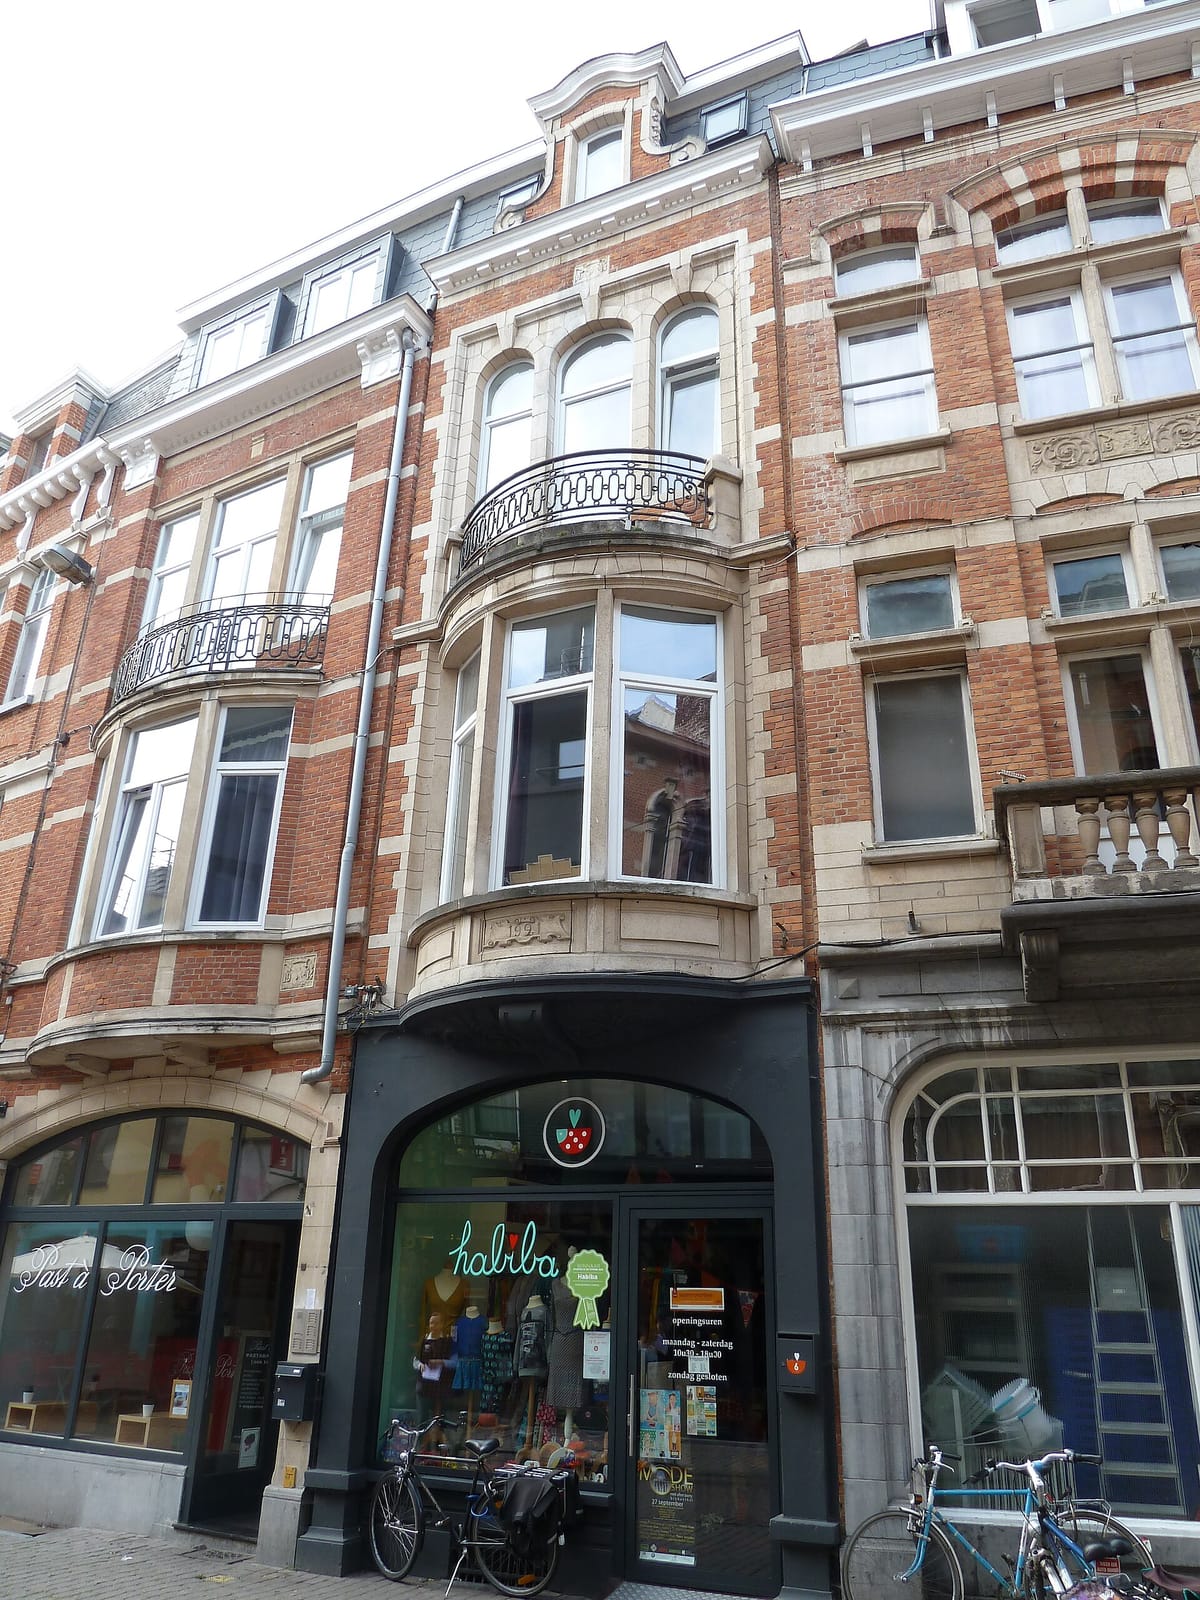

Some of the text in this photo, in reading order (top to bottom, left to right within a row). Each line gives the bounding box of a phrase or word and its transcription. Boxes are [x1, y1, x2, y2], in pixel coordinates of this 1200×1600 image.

[449, 1220, 559, 1278] habiba
[14, 1244, 177, 1296] Past à Porter
[672, 1316, 723, 1327] openingsuren
[662, 1338, 696, 1348] maandag
[701, 1339, 734, 1350] zaterdag
[673, 1349, 695, 1357] 10u30
[700, 1350, 722, 1359] 18u30
[793, 1362, 800, 1371] 6
[667, 1371, 728, 1382] zondag gesloten
[671, 1484, 693, 1493] SHOW
[658, 1500, 684, 1508] september
